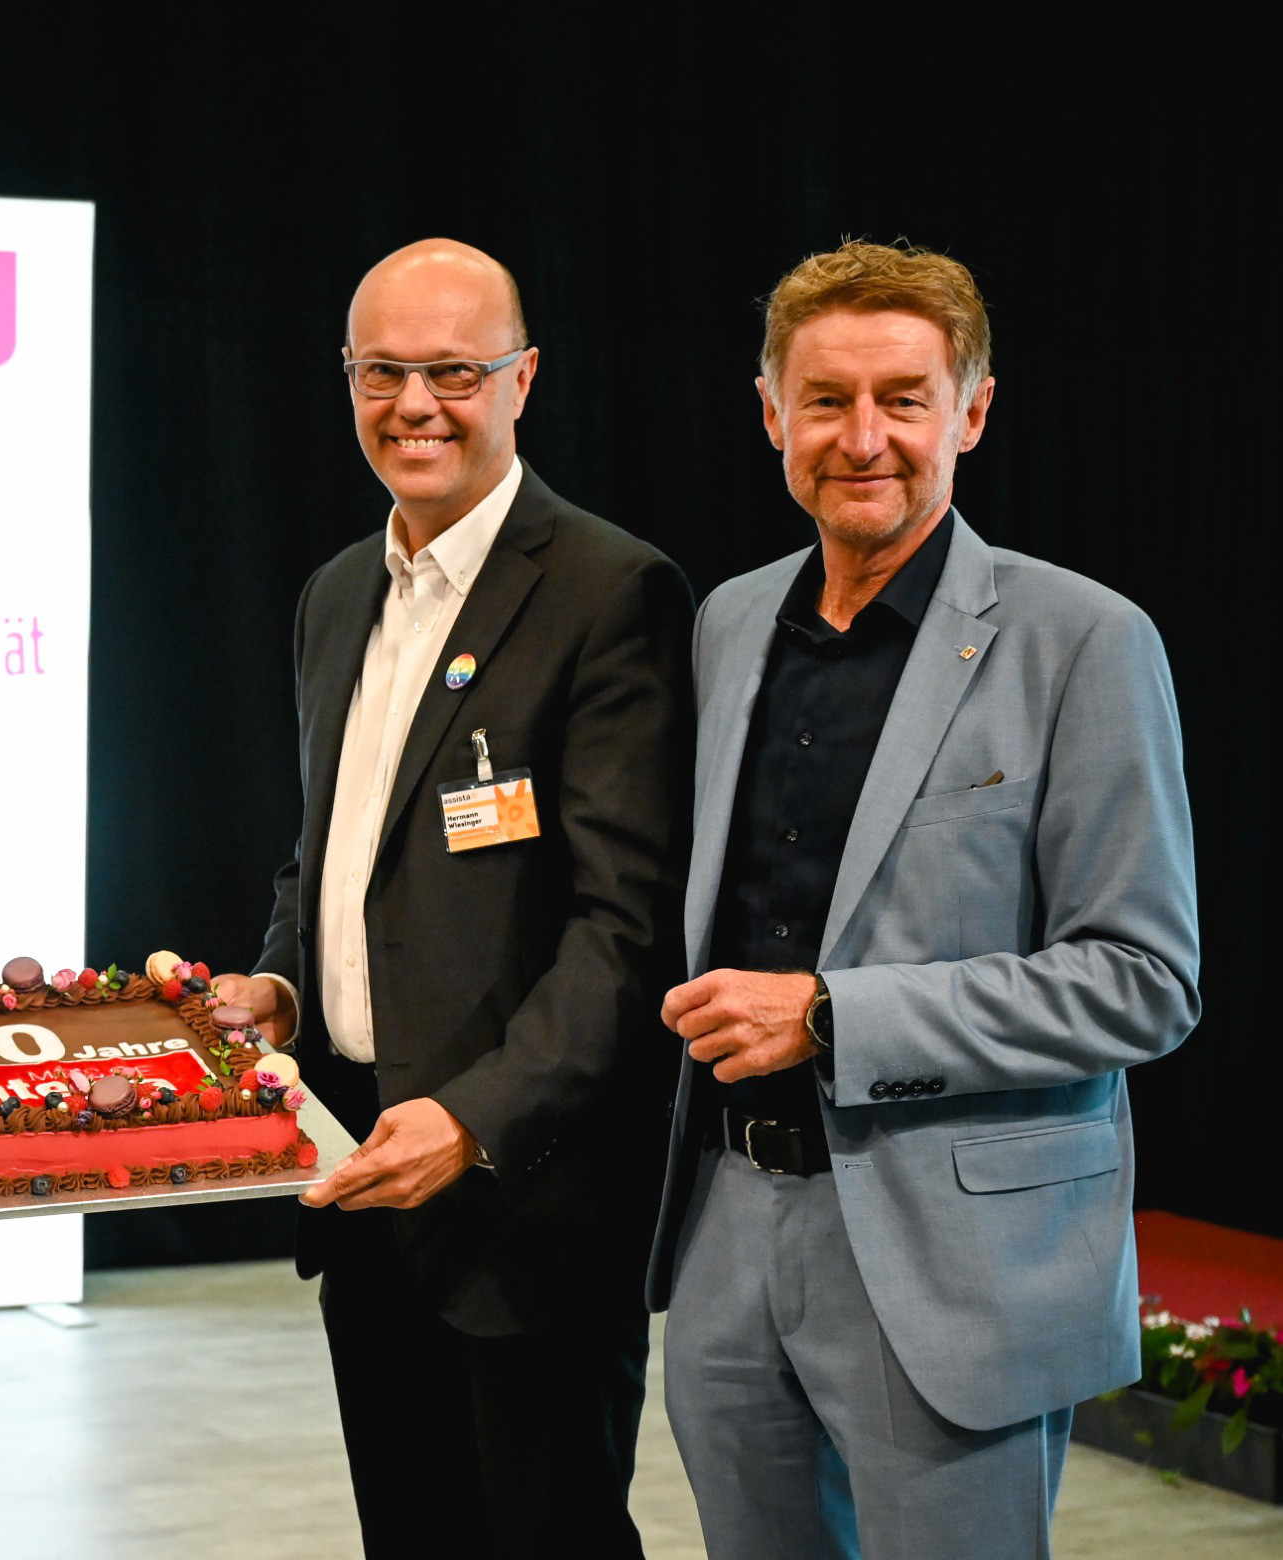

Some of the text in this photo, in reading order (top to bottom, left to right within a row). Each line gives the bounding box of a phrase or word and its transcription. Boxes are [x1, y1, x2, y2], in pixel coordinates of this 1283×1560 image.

[443, 794, 471, 805] assista
[447, 811, 479, 822] Hermann
[448, 819, 482, 829] Wiesinger
[72, 1038, 189, 1060] Jahre
